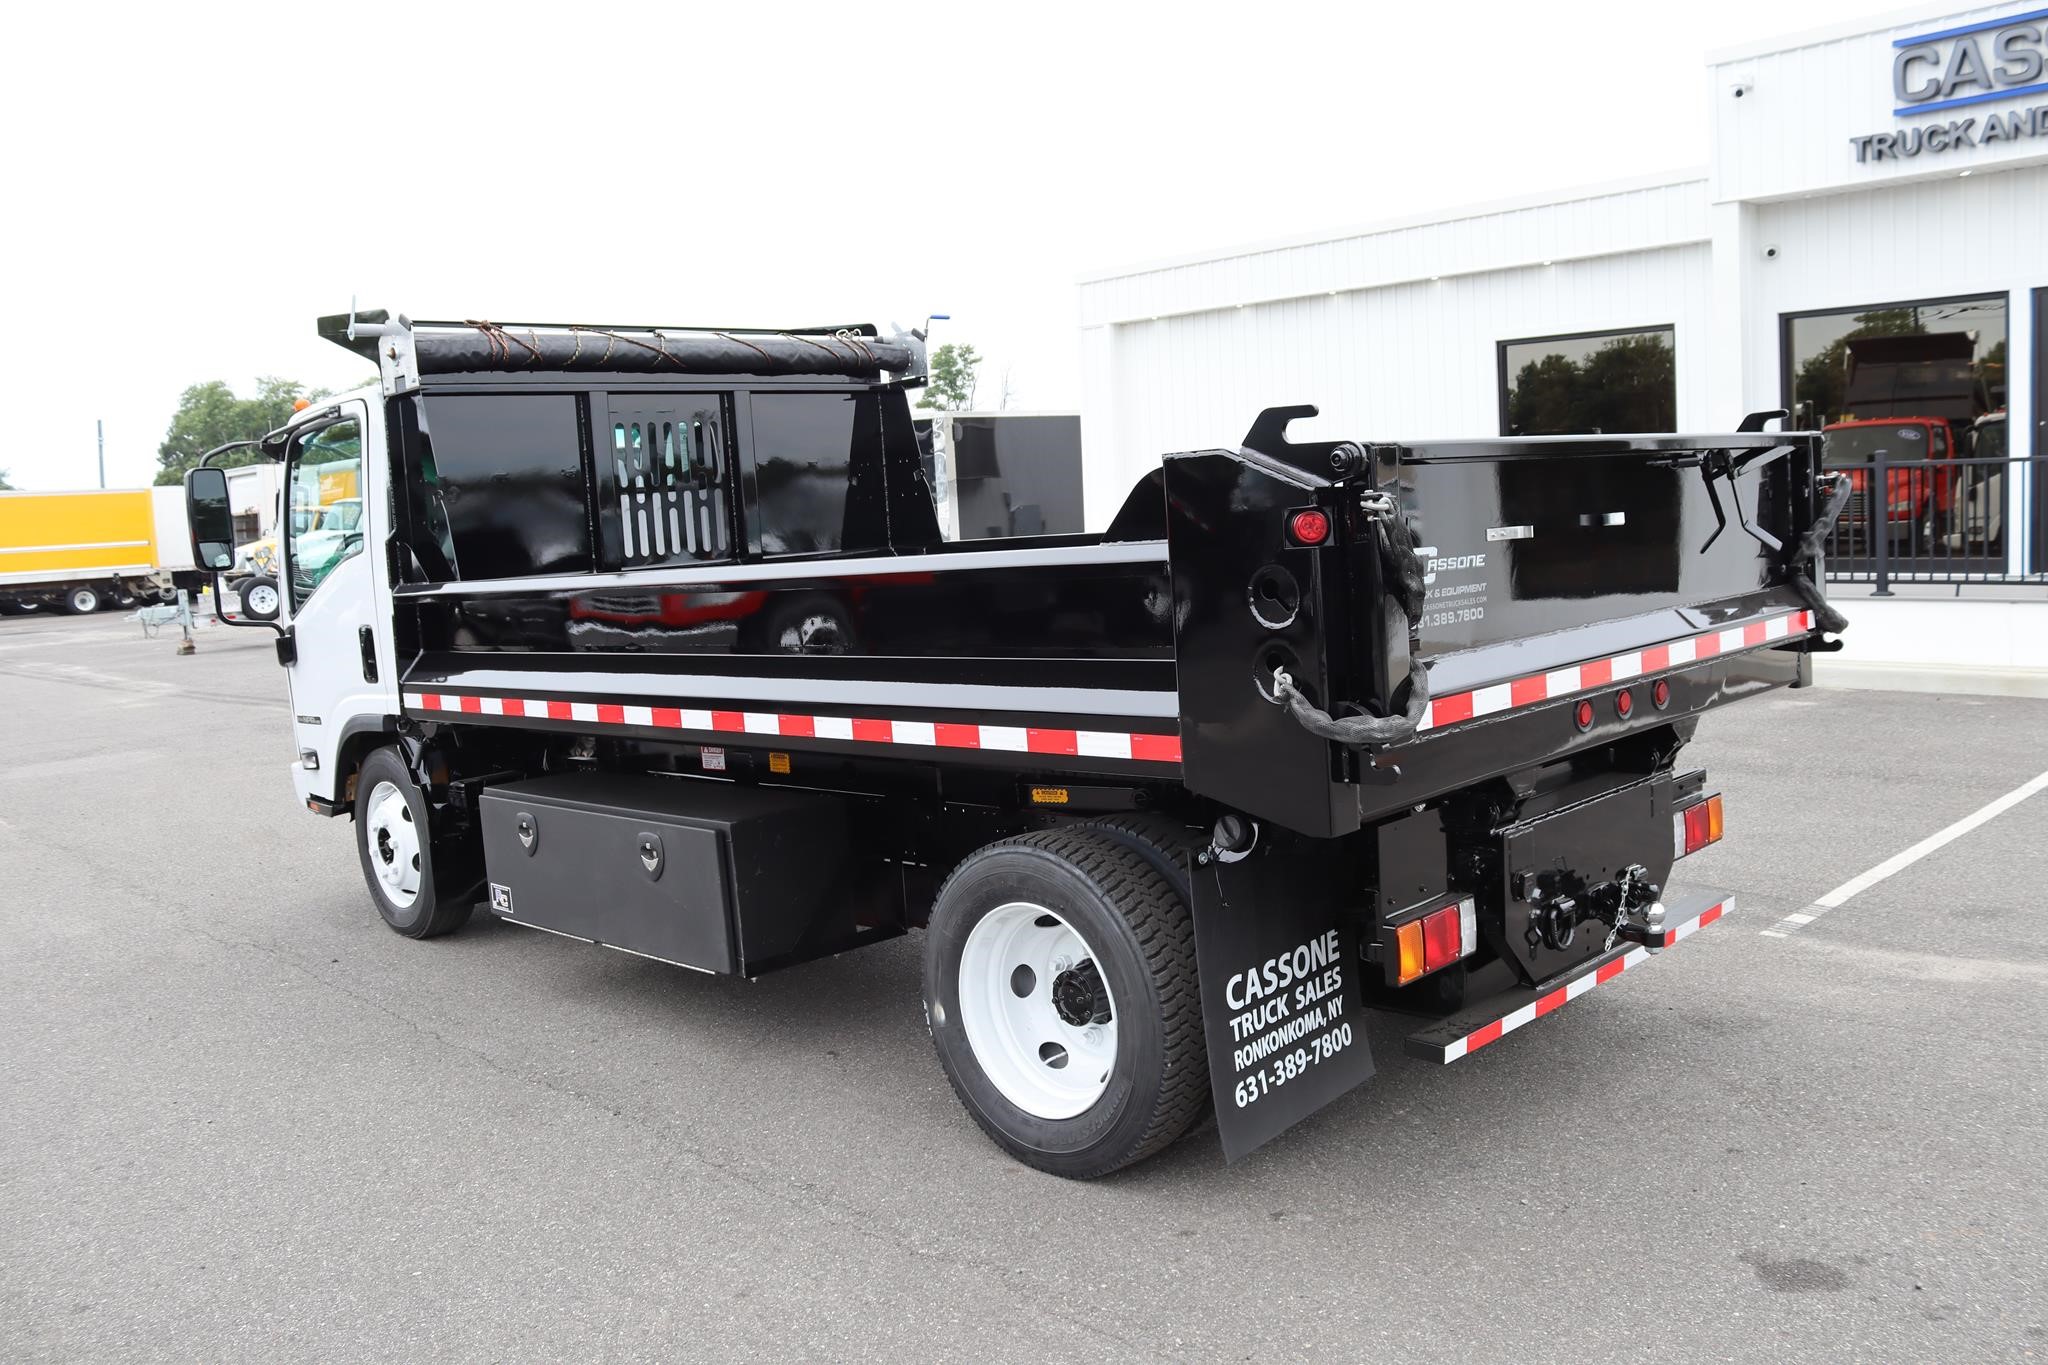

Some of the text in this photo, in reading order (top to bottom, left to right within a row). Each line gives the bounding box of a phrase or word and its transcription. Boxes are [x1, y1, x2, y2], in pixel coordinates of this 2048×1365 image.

[1893, 25, 2048, 102] CAS
[1850, 117, 1977, 163] TRUCK
[1411, 607, 1484, 629] 31.389.7800
[1441, 583, 1487, 597] EQUIPMENT
[1226, 928, 1340, 1011] CASSONE
[1229, 966, 1342, 1042] TRUCK SALES
[1234, 995, 1343, 1072] RONKONKOMA, NY
[1235, 1022, 1352, 1108] 631-389-7800
